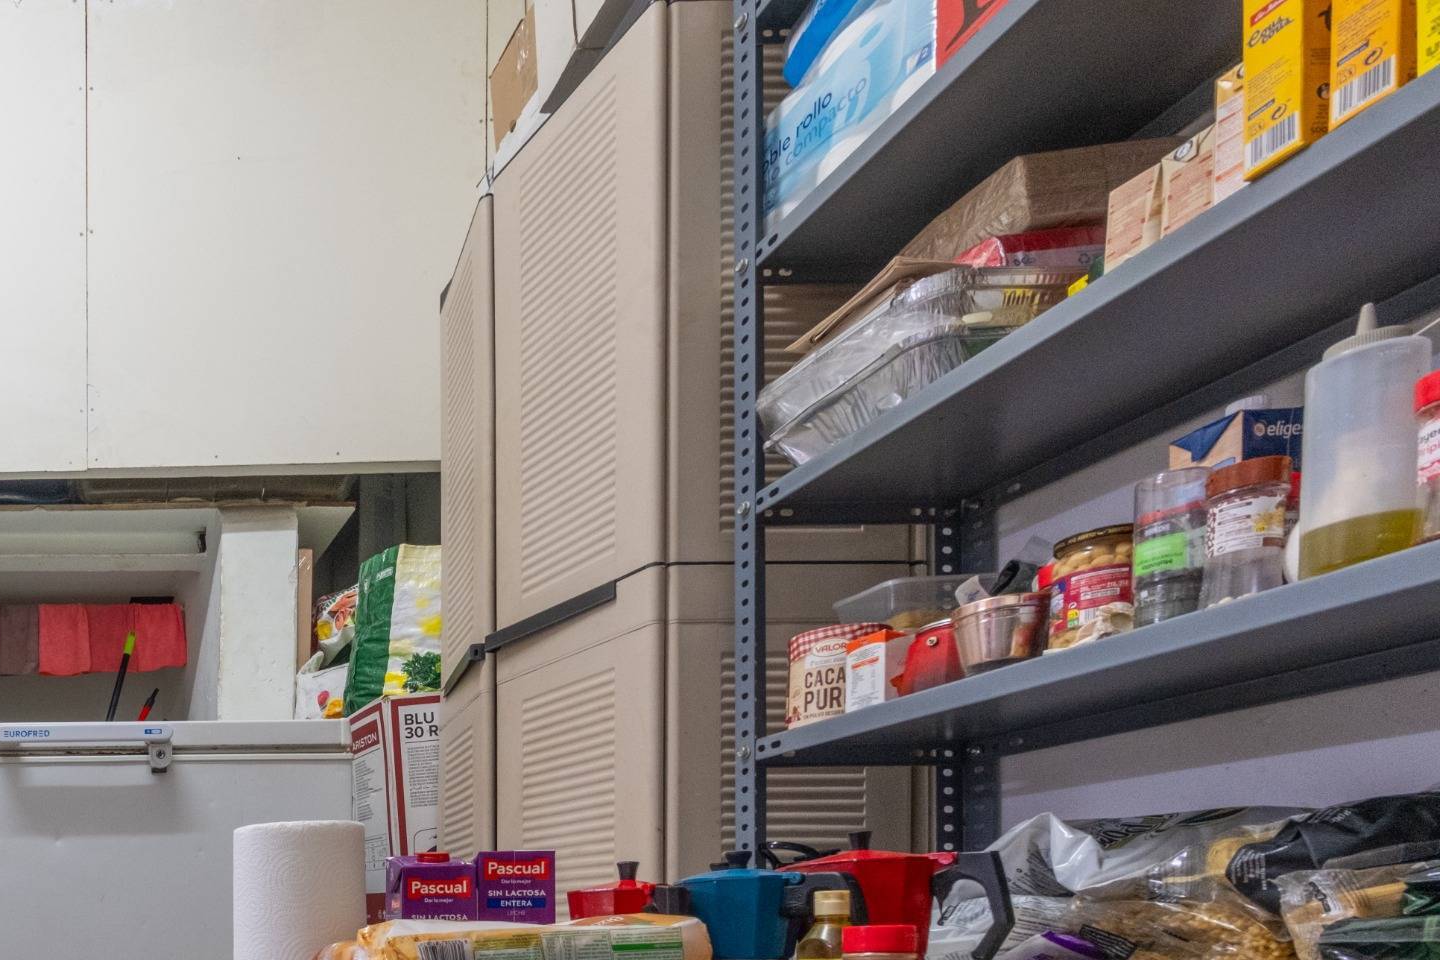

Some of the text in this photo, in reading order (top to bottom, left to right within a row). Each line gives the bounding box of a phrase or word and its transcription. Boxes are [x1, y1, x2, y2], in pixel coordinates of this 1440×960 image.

[796, 91, 832, 138] rollo
[1266, 419, 1303, 439] elige
[814, 642, 847, 653] VALOR
[804, 686, 842, 713] PUR
[404, 712, 435, 726] BLU
[3, 729, 50, 738] EUROFRED
[405, 726, 424, 739] 30
[352, 732, 378, 752] ARISTON
[488, 861, 545, 875] Pascual
[411, 879, 467, 894] Pascual
[488, 889, 546, 897] SIN LACTOSA
